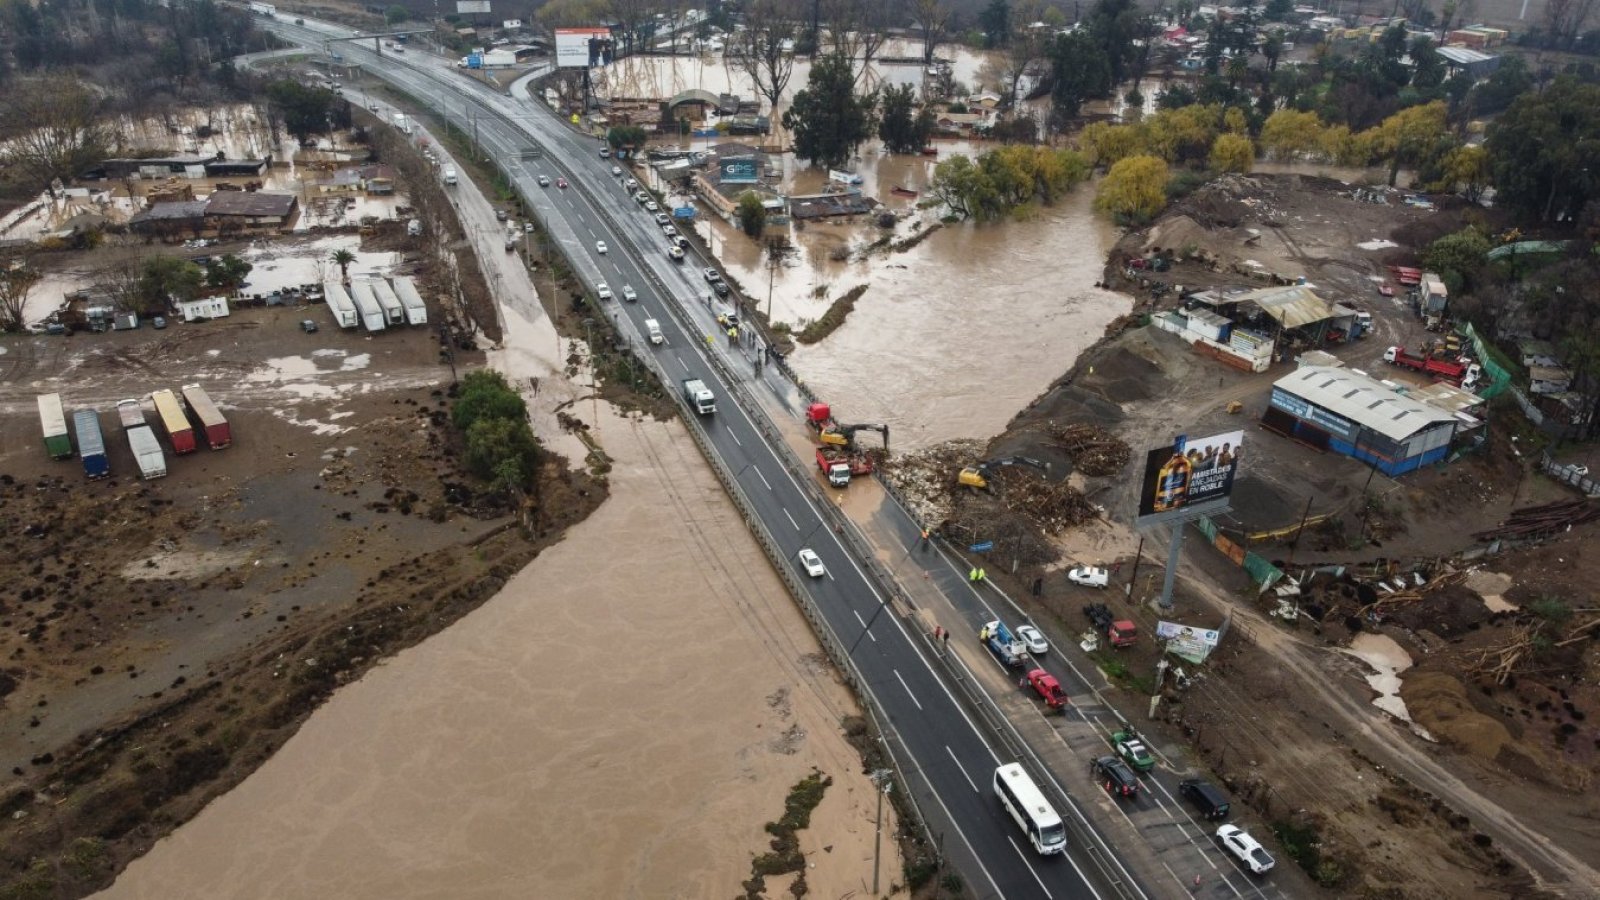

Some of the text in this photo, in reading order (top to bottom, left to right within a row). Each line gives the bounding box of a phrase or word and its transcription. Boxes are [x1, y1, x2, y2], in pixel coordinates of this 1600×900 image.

[726, 164, 752, 173] GPS
[1192, 465, 1231, 479] AMISTADES
[1190, 473, 1227, 488] AÑEJADAS
[1189, 481, 1224, 495] EN ROBLE
